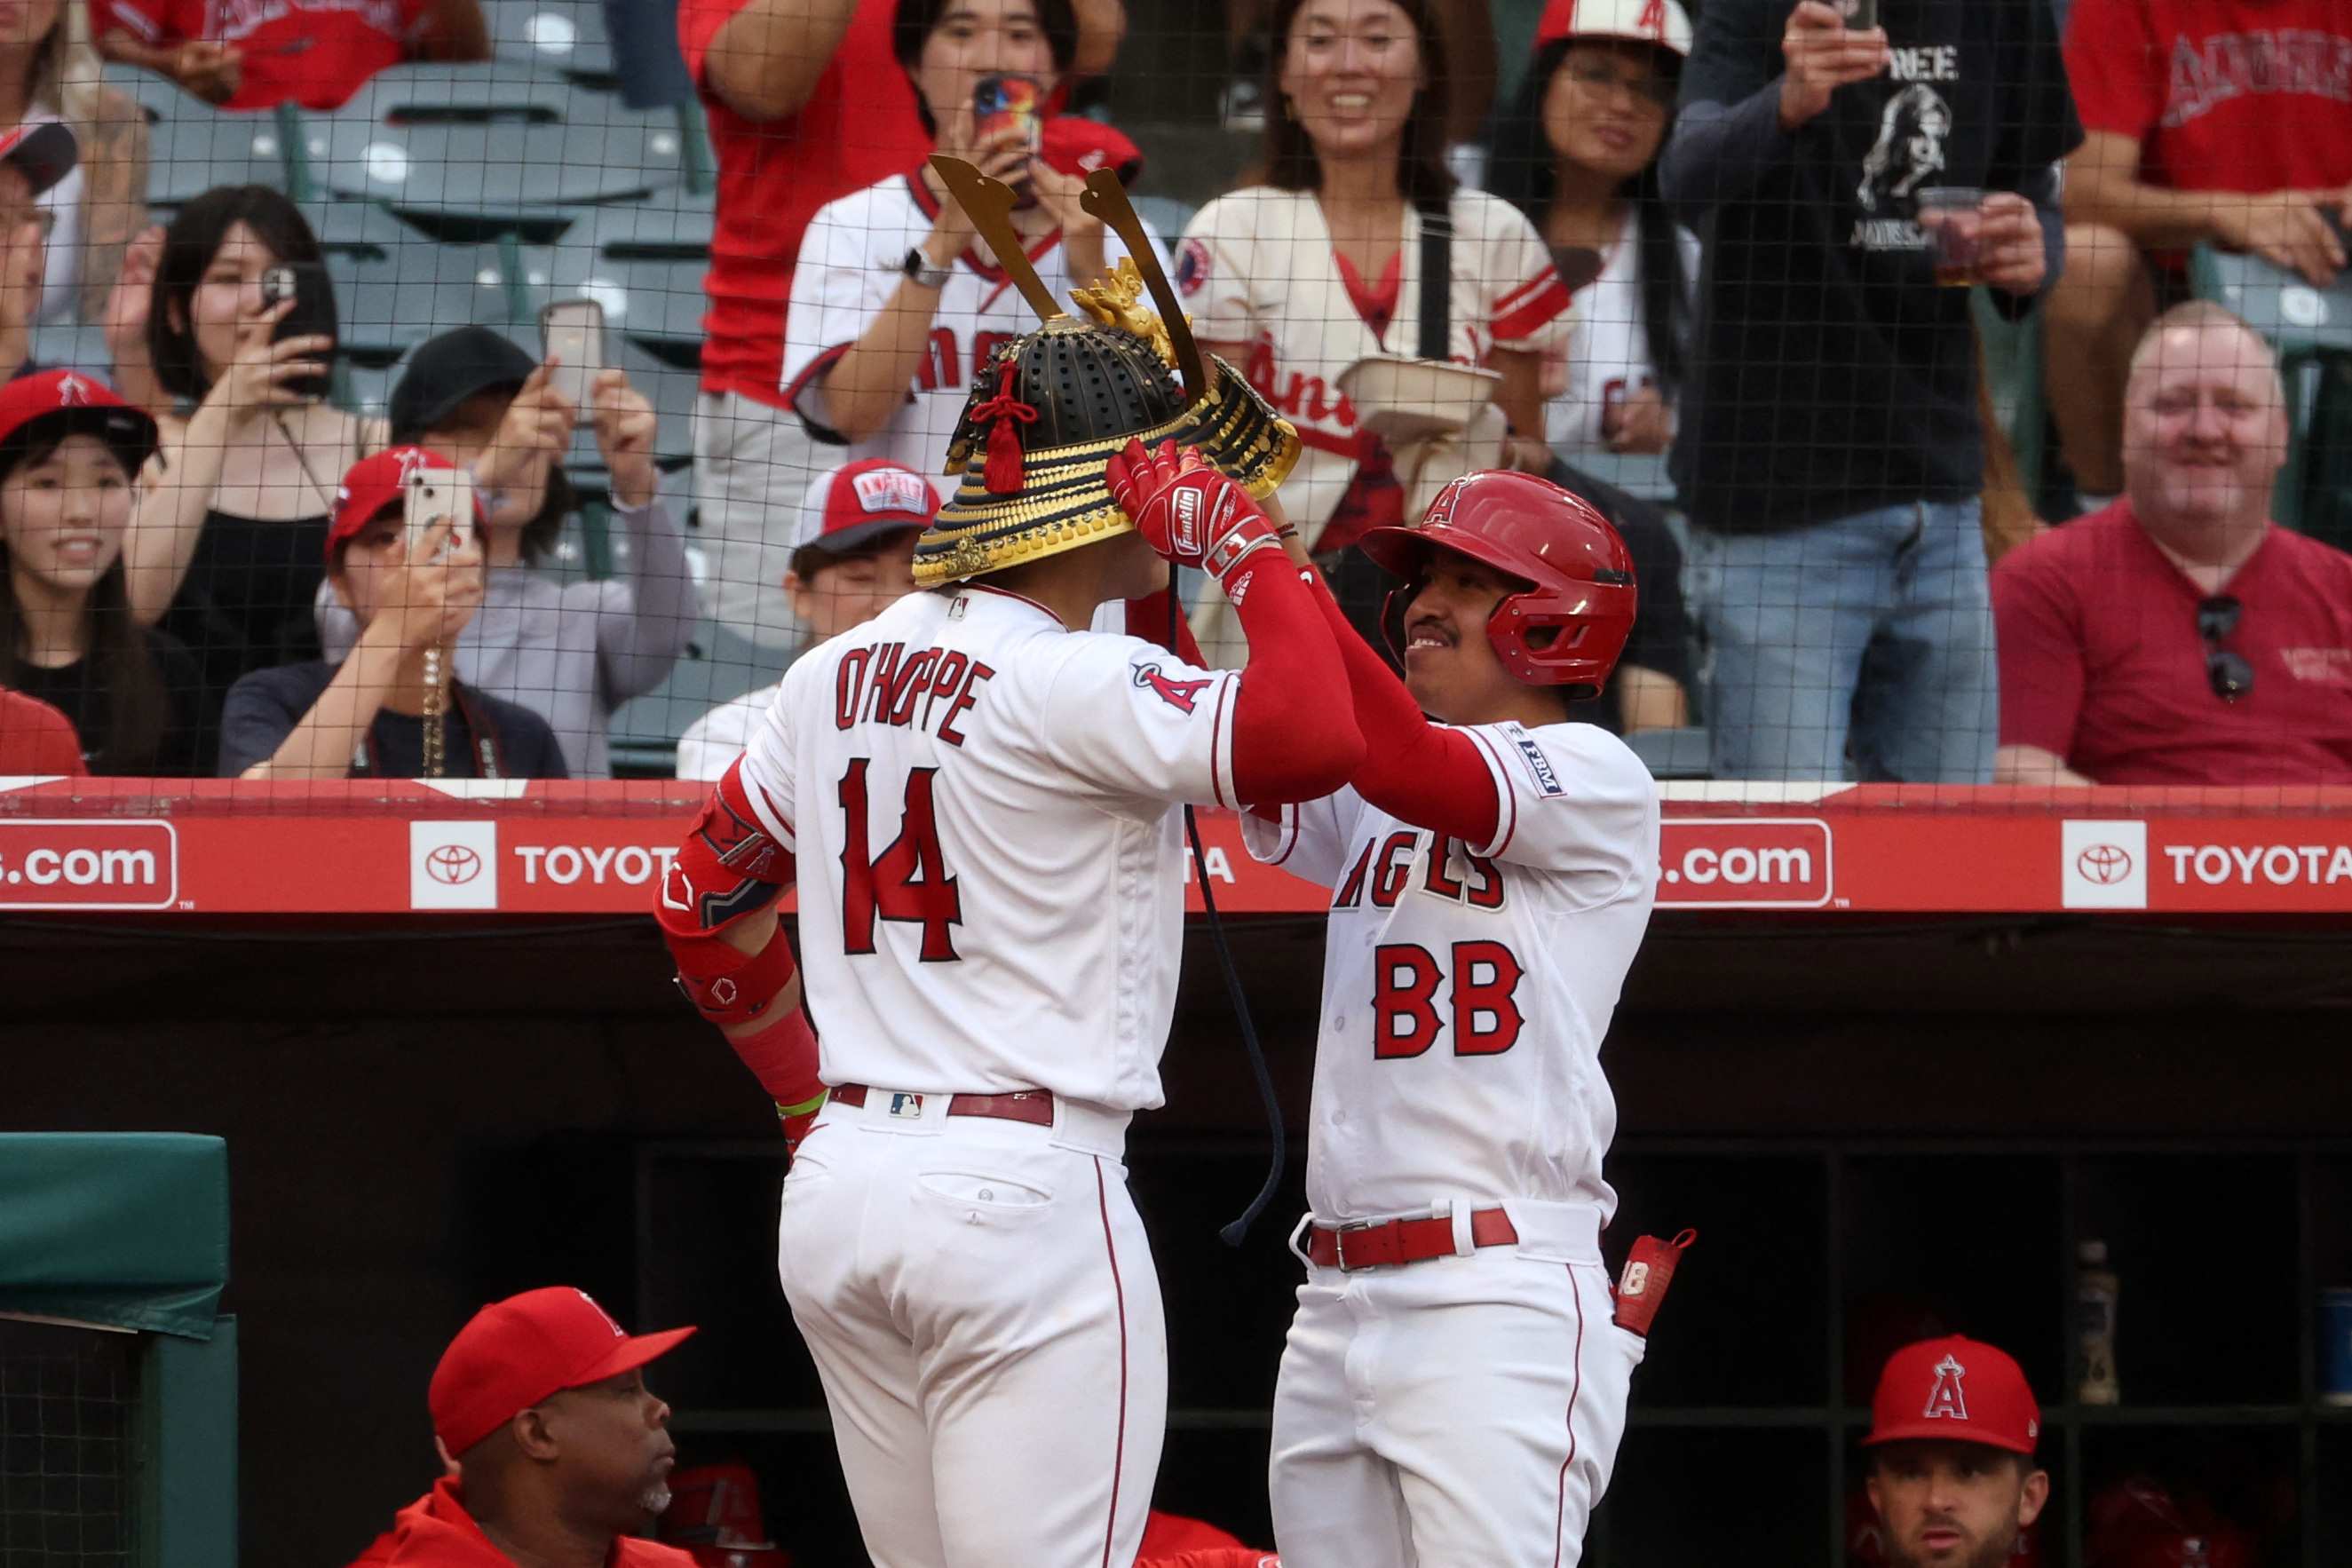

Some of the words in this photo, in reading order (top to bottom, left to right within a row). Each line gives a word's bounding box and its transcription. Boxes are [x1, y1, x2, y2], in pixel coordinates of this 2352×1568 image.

[835, 641, 997, 748] O'HOPPE
[1523, 744, 1558, 789] FBM
[0, 848, 155, 885] .com
[514, 845, 680, 885] TOYOT
[837, 757, 963, 962] 14
[1659, 847, 1811, 884] .com
[2164, 844, 2352, 885] TOYOTA
[1371, 939, 1525, 1060] BB
